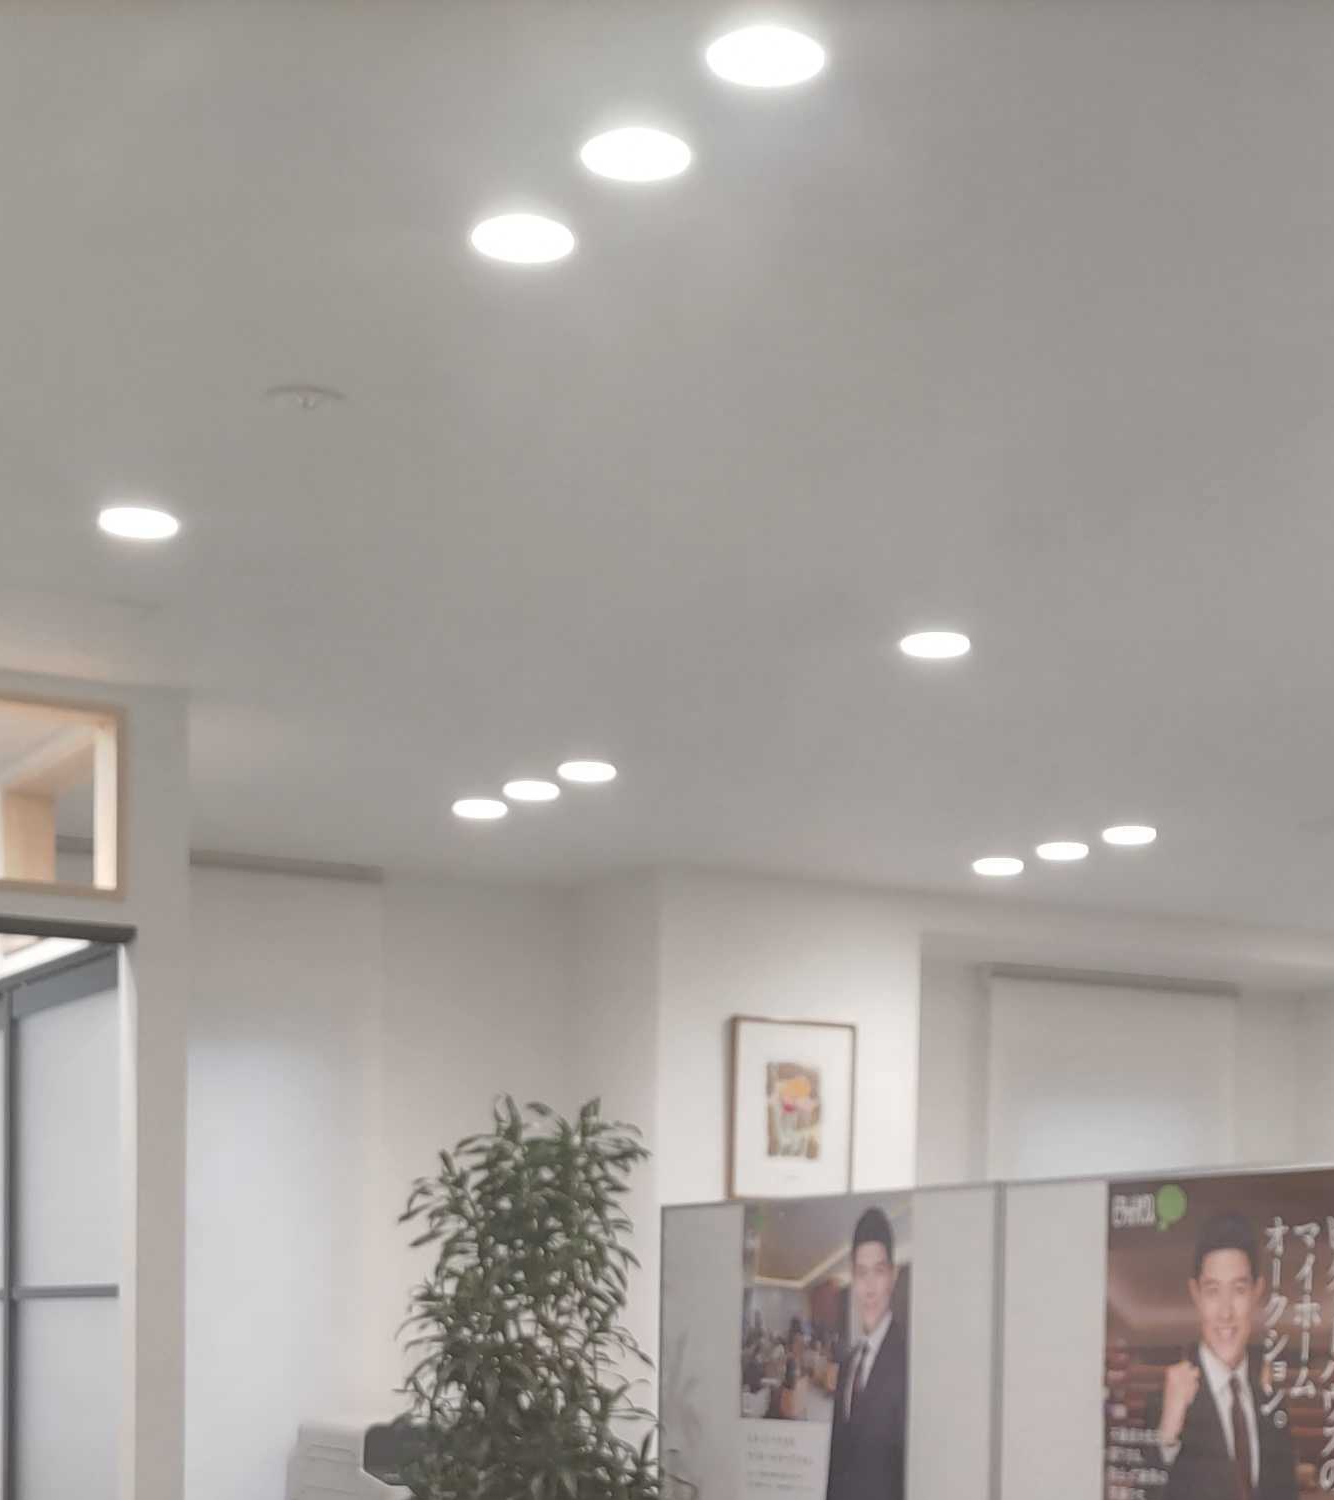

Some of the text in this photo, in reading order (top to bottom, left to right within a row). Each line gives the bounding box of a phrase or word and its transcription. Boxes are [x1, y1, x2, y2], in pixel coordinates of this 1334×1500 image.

[1290, 1222, 1322, 1397] マイホーム
